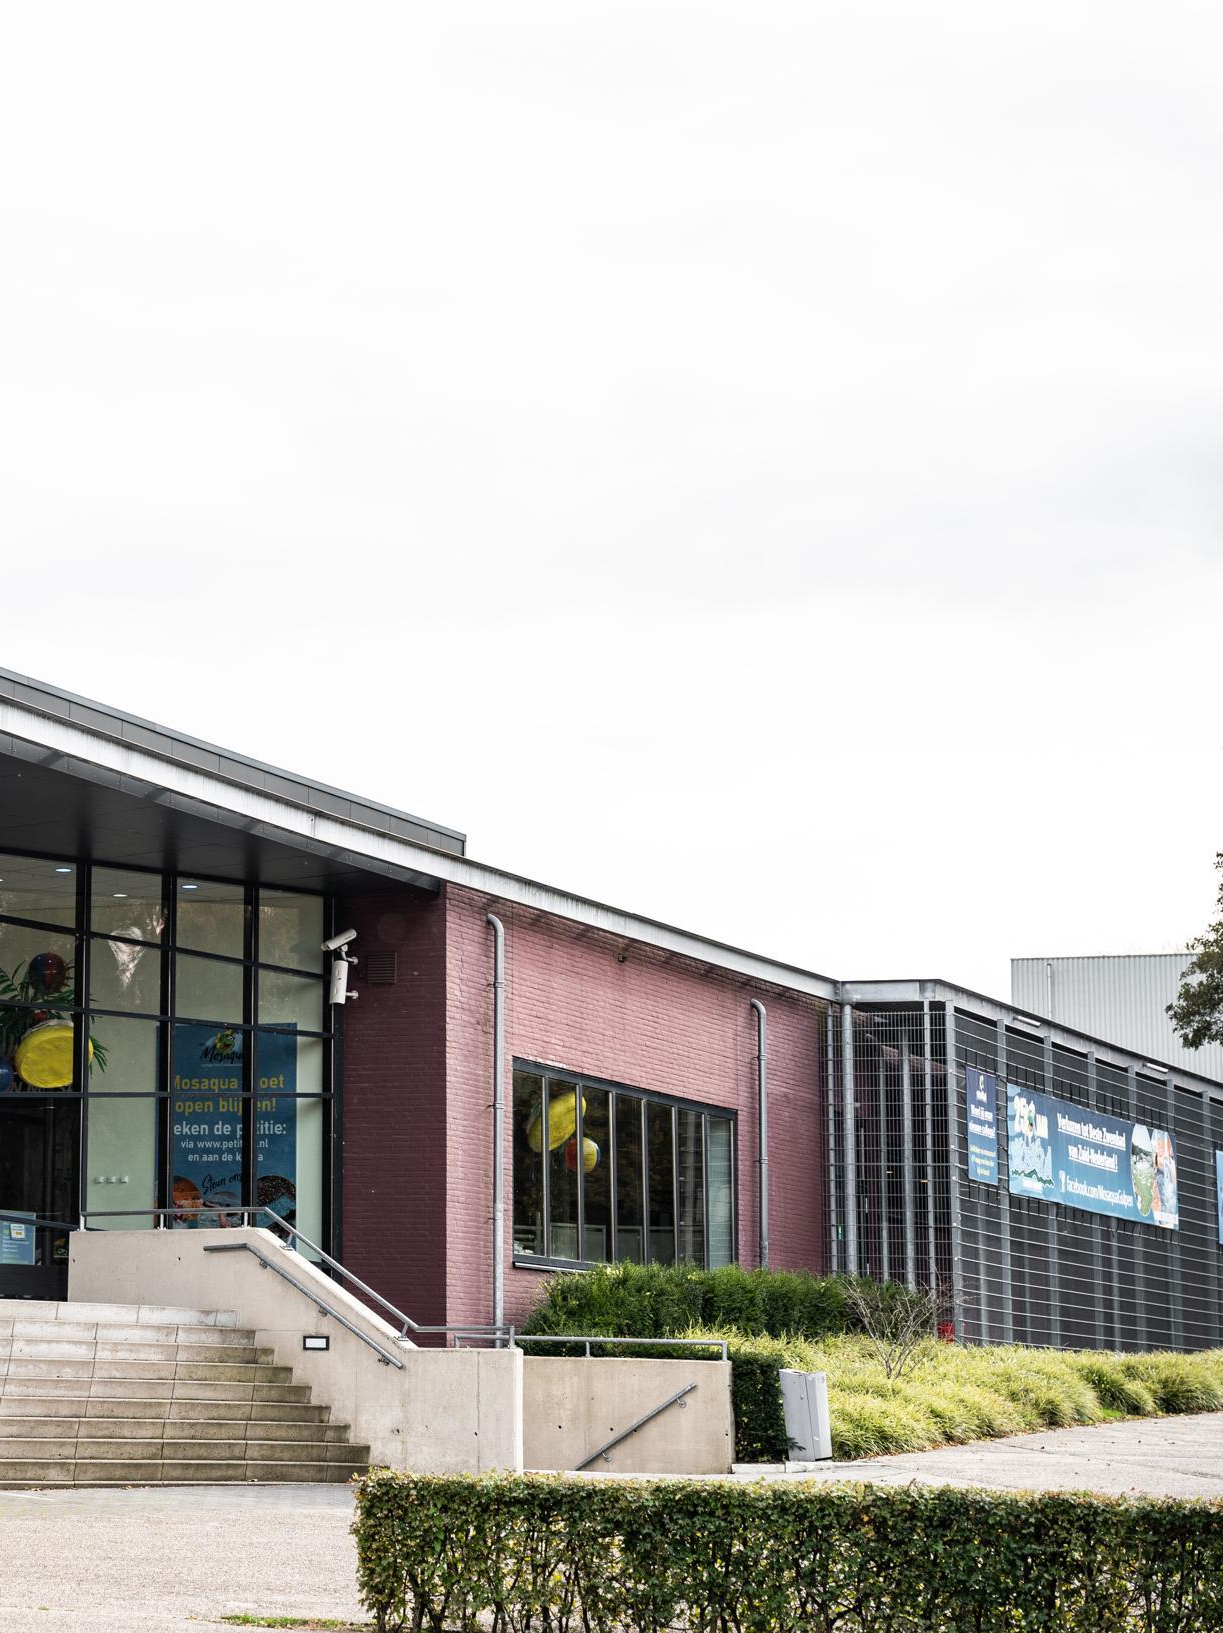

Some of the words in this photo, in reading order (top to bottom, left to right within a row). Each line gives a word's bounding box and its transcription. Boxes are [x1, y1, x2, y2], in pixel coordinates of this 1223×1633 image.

[200, 1044, 243, 1064] Mosaqu
[259, 1074, 285, 1088] oet
[175, 1100, 213, 1116] open
[219, 1097, 276, 1116] blijn!
[173, 1121, 208, 1135] eken
[213, 1121, 232, 1135] de
[237, 1120, 287, 1138] pitie:
[180, 1139, 194, 1149] via
[197, 1139, 268, 1150] www.petit.nl
[188, 1154, 199, 1162] en
[202, 1154, 219, 1162] aan
[221, 1152, 233, 1162] de
